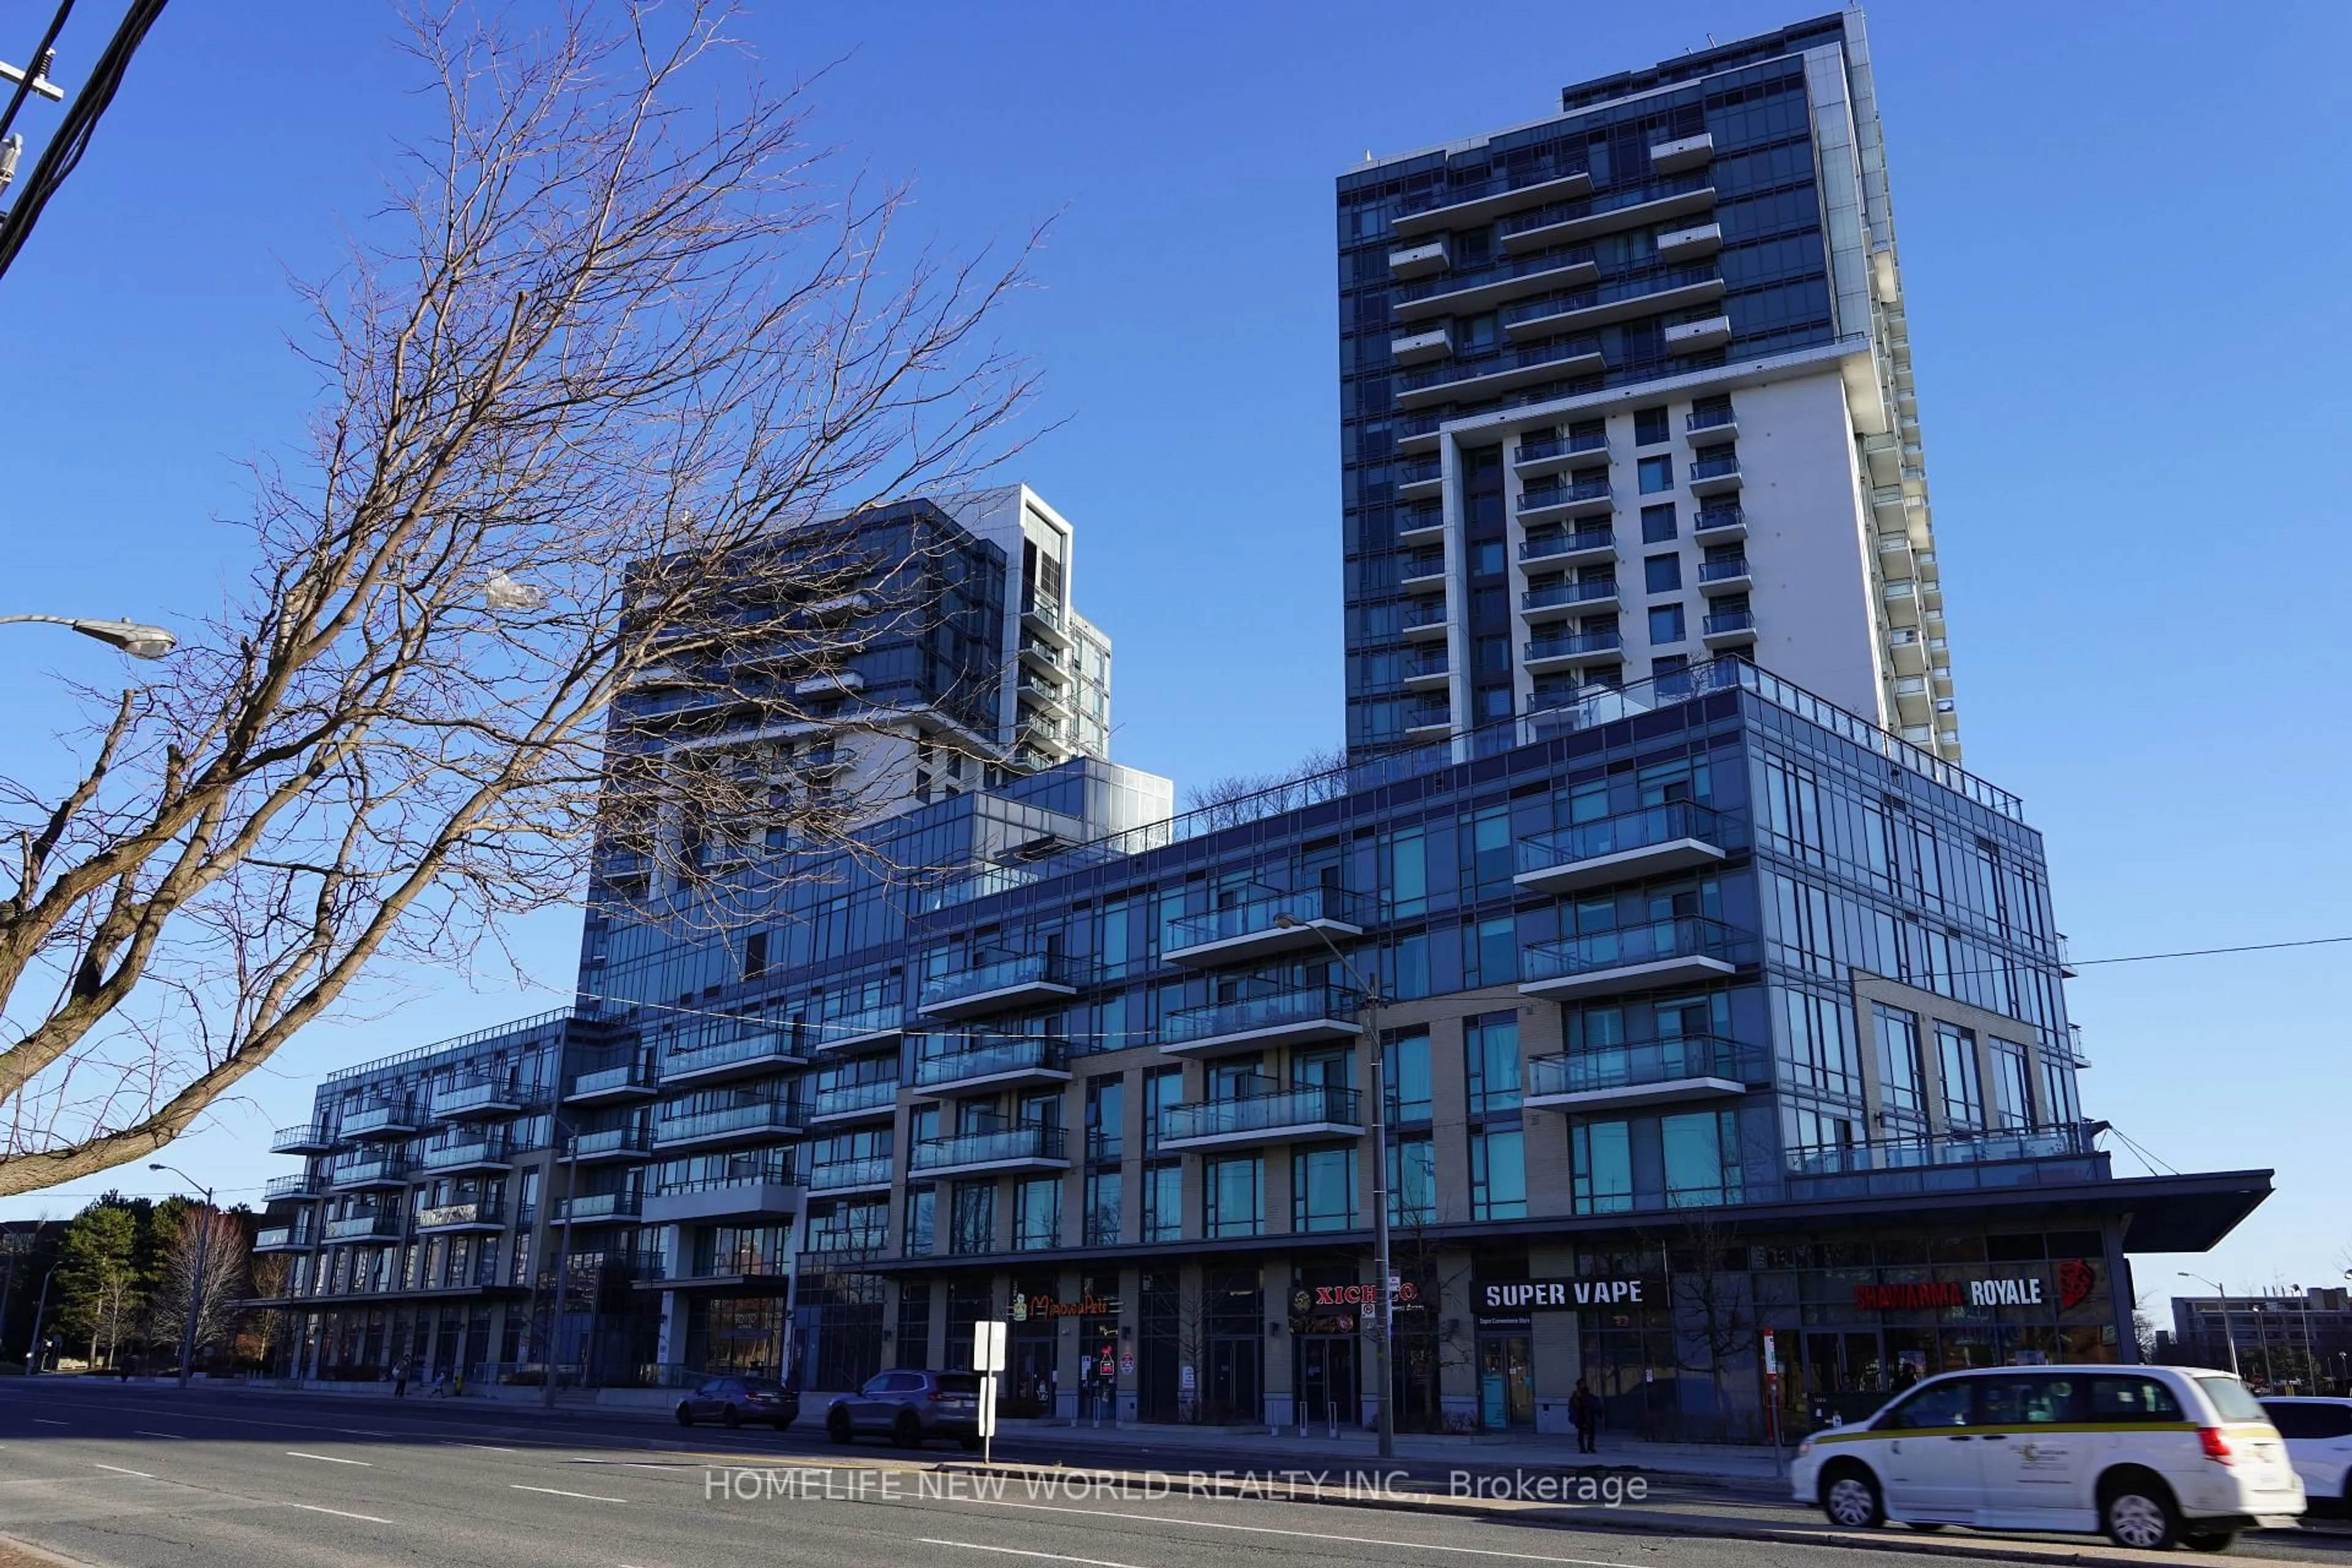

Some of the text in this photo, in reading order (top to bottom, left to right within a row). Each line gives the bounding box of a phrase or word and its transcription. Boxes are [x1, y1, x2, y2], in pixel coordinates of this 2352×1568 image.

[1487, 1280, 1643, 1306] SUPER VAPE
[1857, 1278, 2041, 1309] SHAWARMA ROYALE
